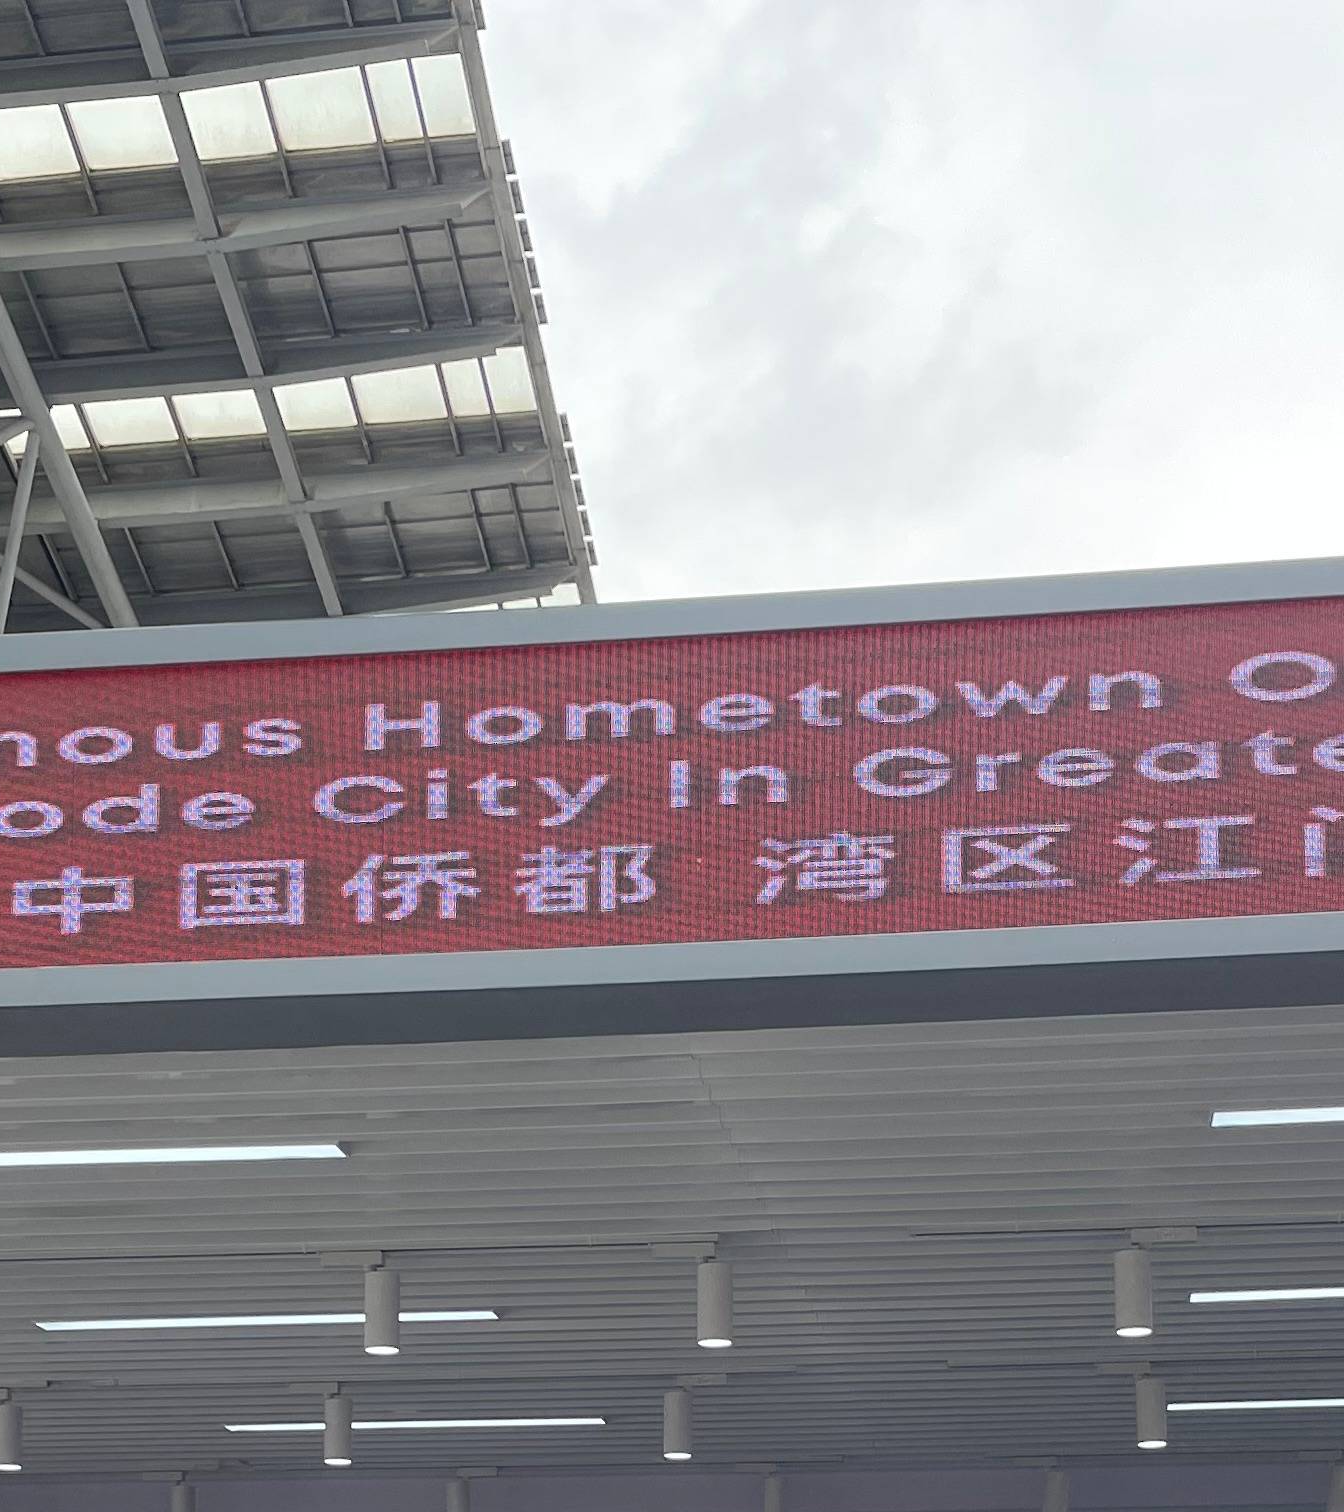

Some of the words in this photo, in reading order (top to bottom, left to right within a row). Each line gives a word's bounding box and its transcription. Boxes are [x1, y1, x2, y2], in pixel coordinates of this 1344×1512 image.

[363, 670, 1163, 751] Hometown
[313, 768, 610, 827] City
[669, 760, 789, 807] In
[12, 844, 656, 935] 中国侨都
